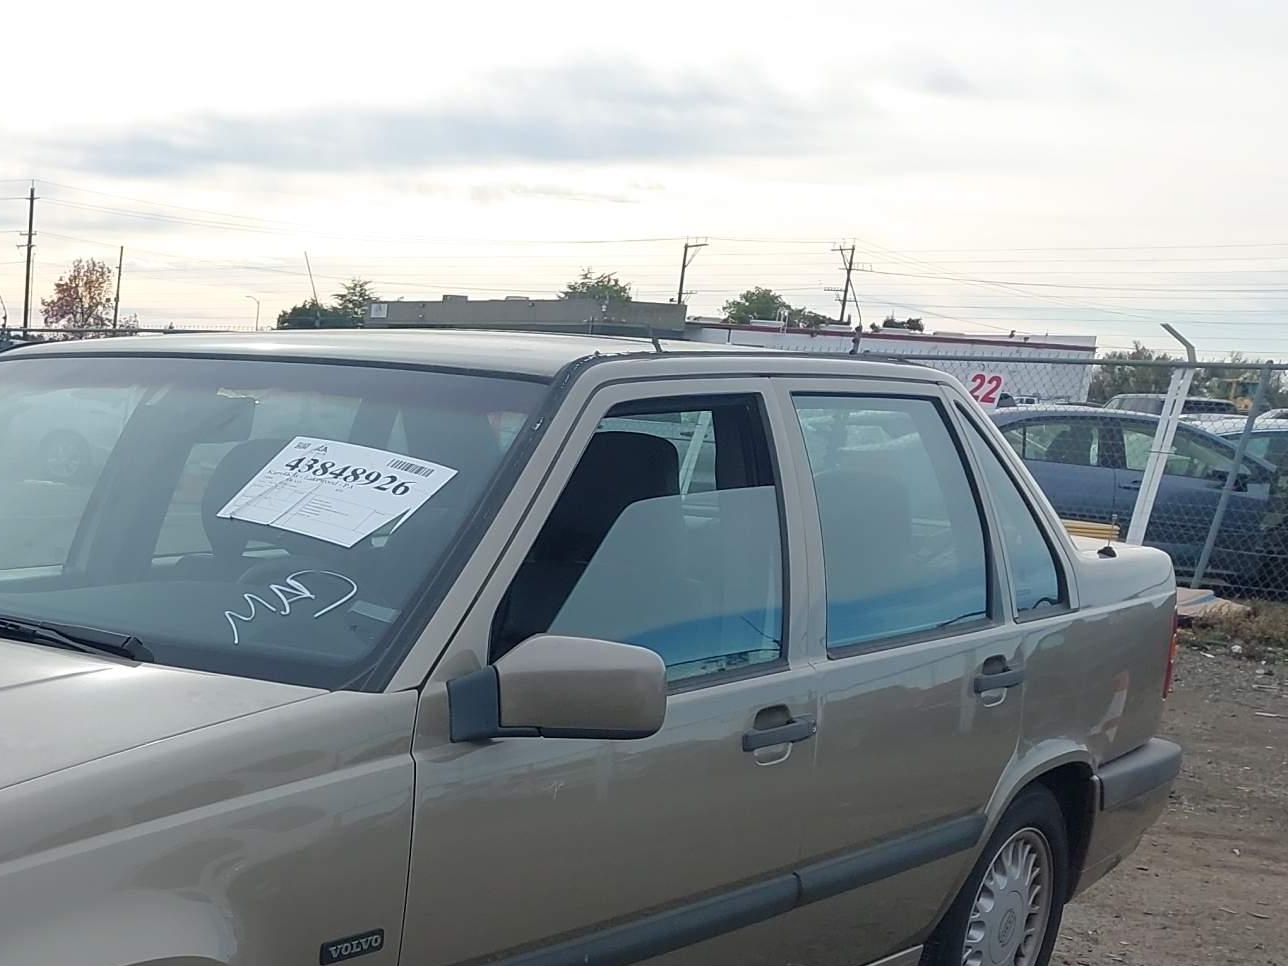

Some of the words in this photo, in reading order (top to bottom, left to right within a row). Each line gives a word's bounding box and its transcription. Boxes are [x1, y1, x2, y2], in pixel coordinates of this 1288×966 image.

[969, 373, 1002, 404] 22
[285, 457, 416, 495] 43848926
[329, 935, 382, 958] VOLVO
